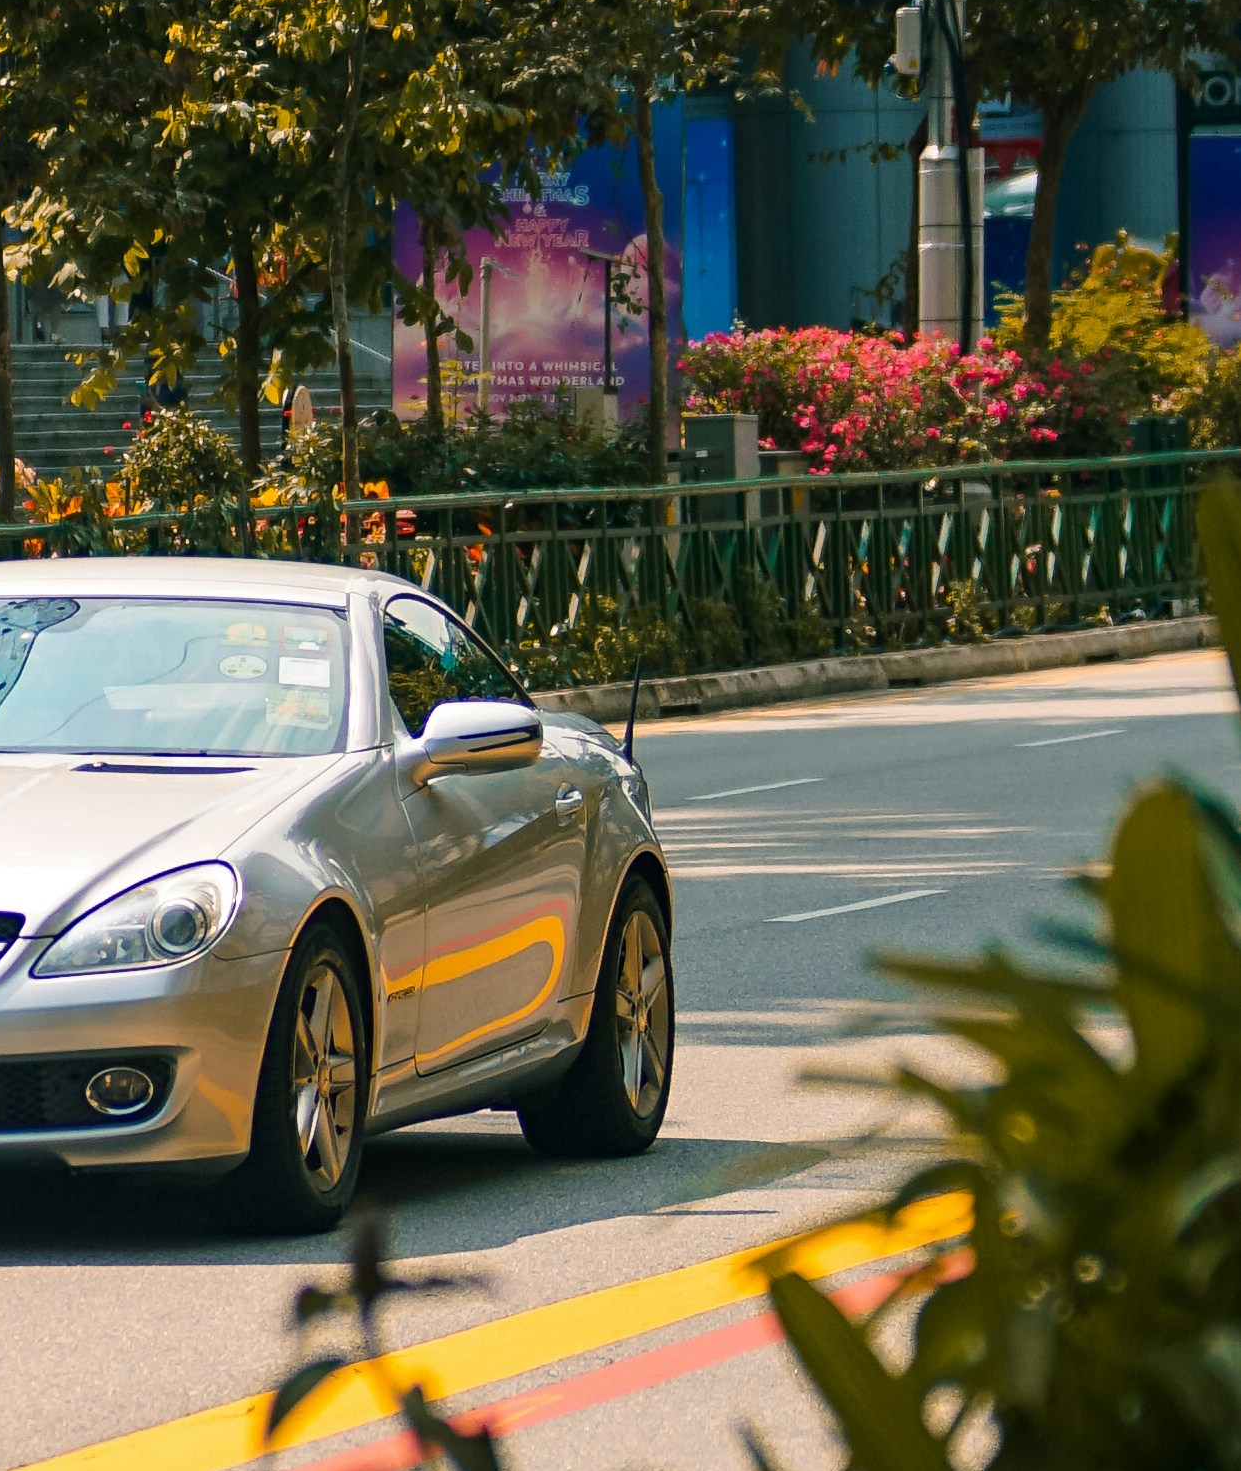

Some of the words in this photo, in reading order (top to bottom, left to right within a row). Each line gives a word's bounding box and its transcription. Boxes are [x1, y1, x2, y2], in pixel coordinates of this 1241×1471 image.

[491, 360, 524, 372] INTO
[528, 360, 538, 372] A
[542, 360, 618, 373] WHIMSICL
